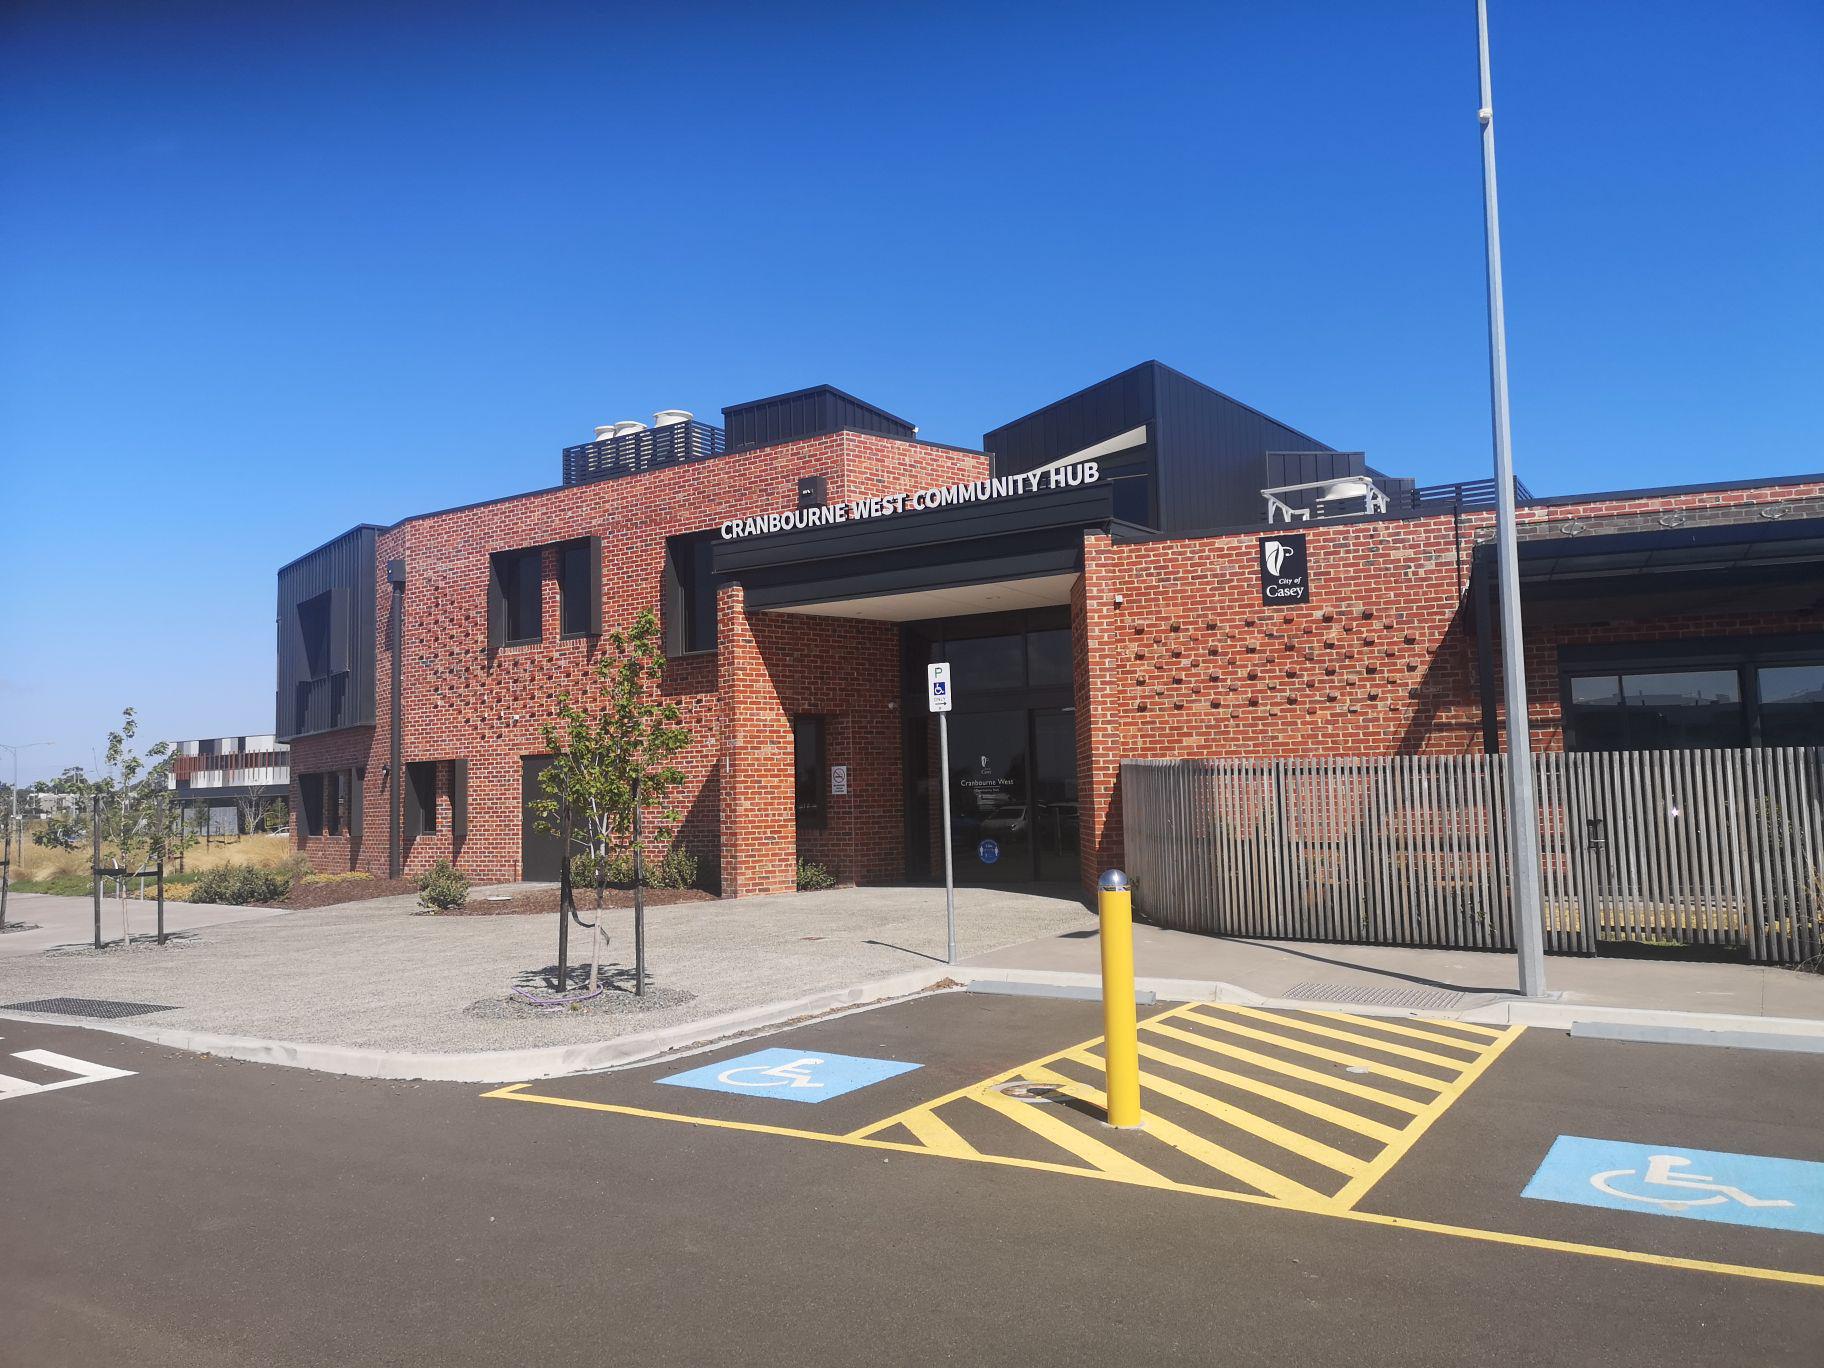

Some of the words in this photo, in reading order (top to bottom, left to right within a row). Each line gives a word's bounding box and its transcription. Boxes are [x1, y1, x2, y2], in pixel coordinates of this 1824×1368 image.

[721, 504, 847, 540] CRANBOURNE
[854, 493, 907, 520] WEST
[913, 470, 1041, 510] COMMUNITY
[1050, 461, 1100, 489] HUB
[1294, 576, 1302, 585] of
[1266, 585, 1305, 599] Casey
[934, 667, 943, 678] P
[960, 779, 997, 787] Cranbourne
